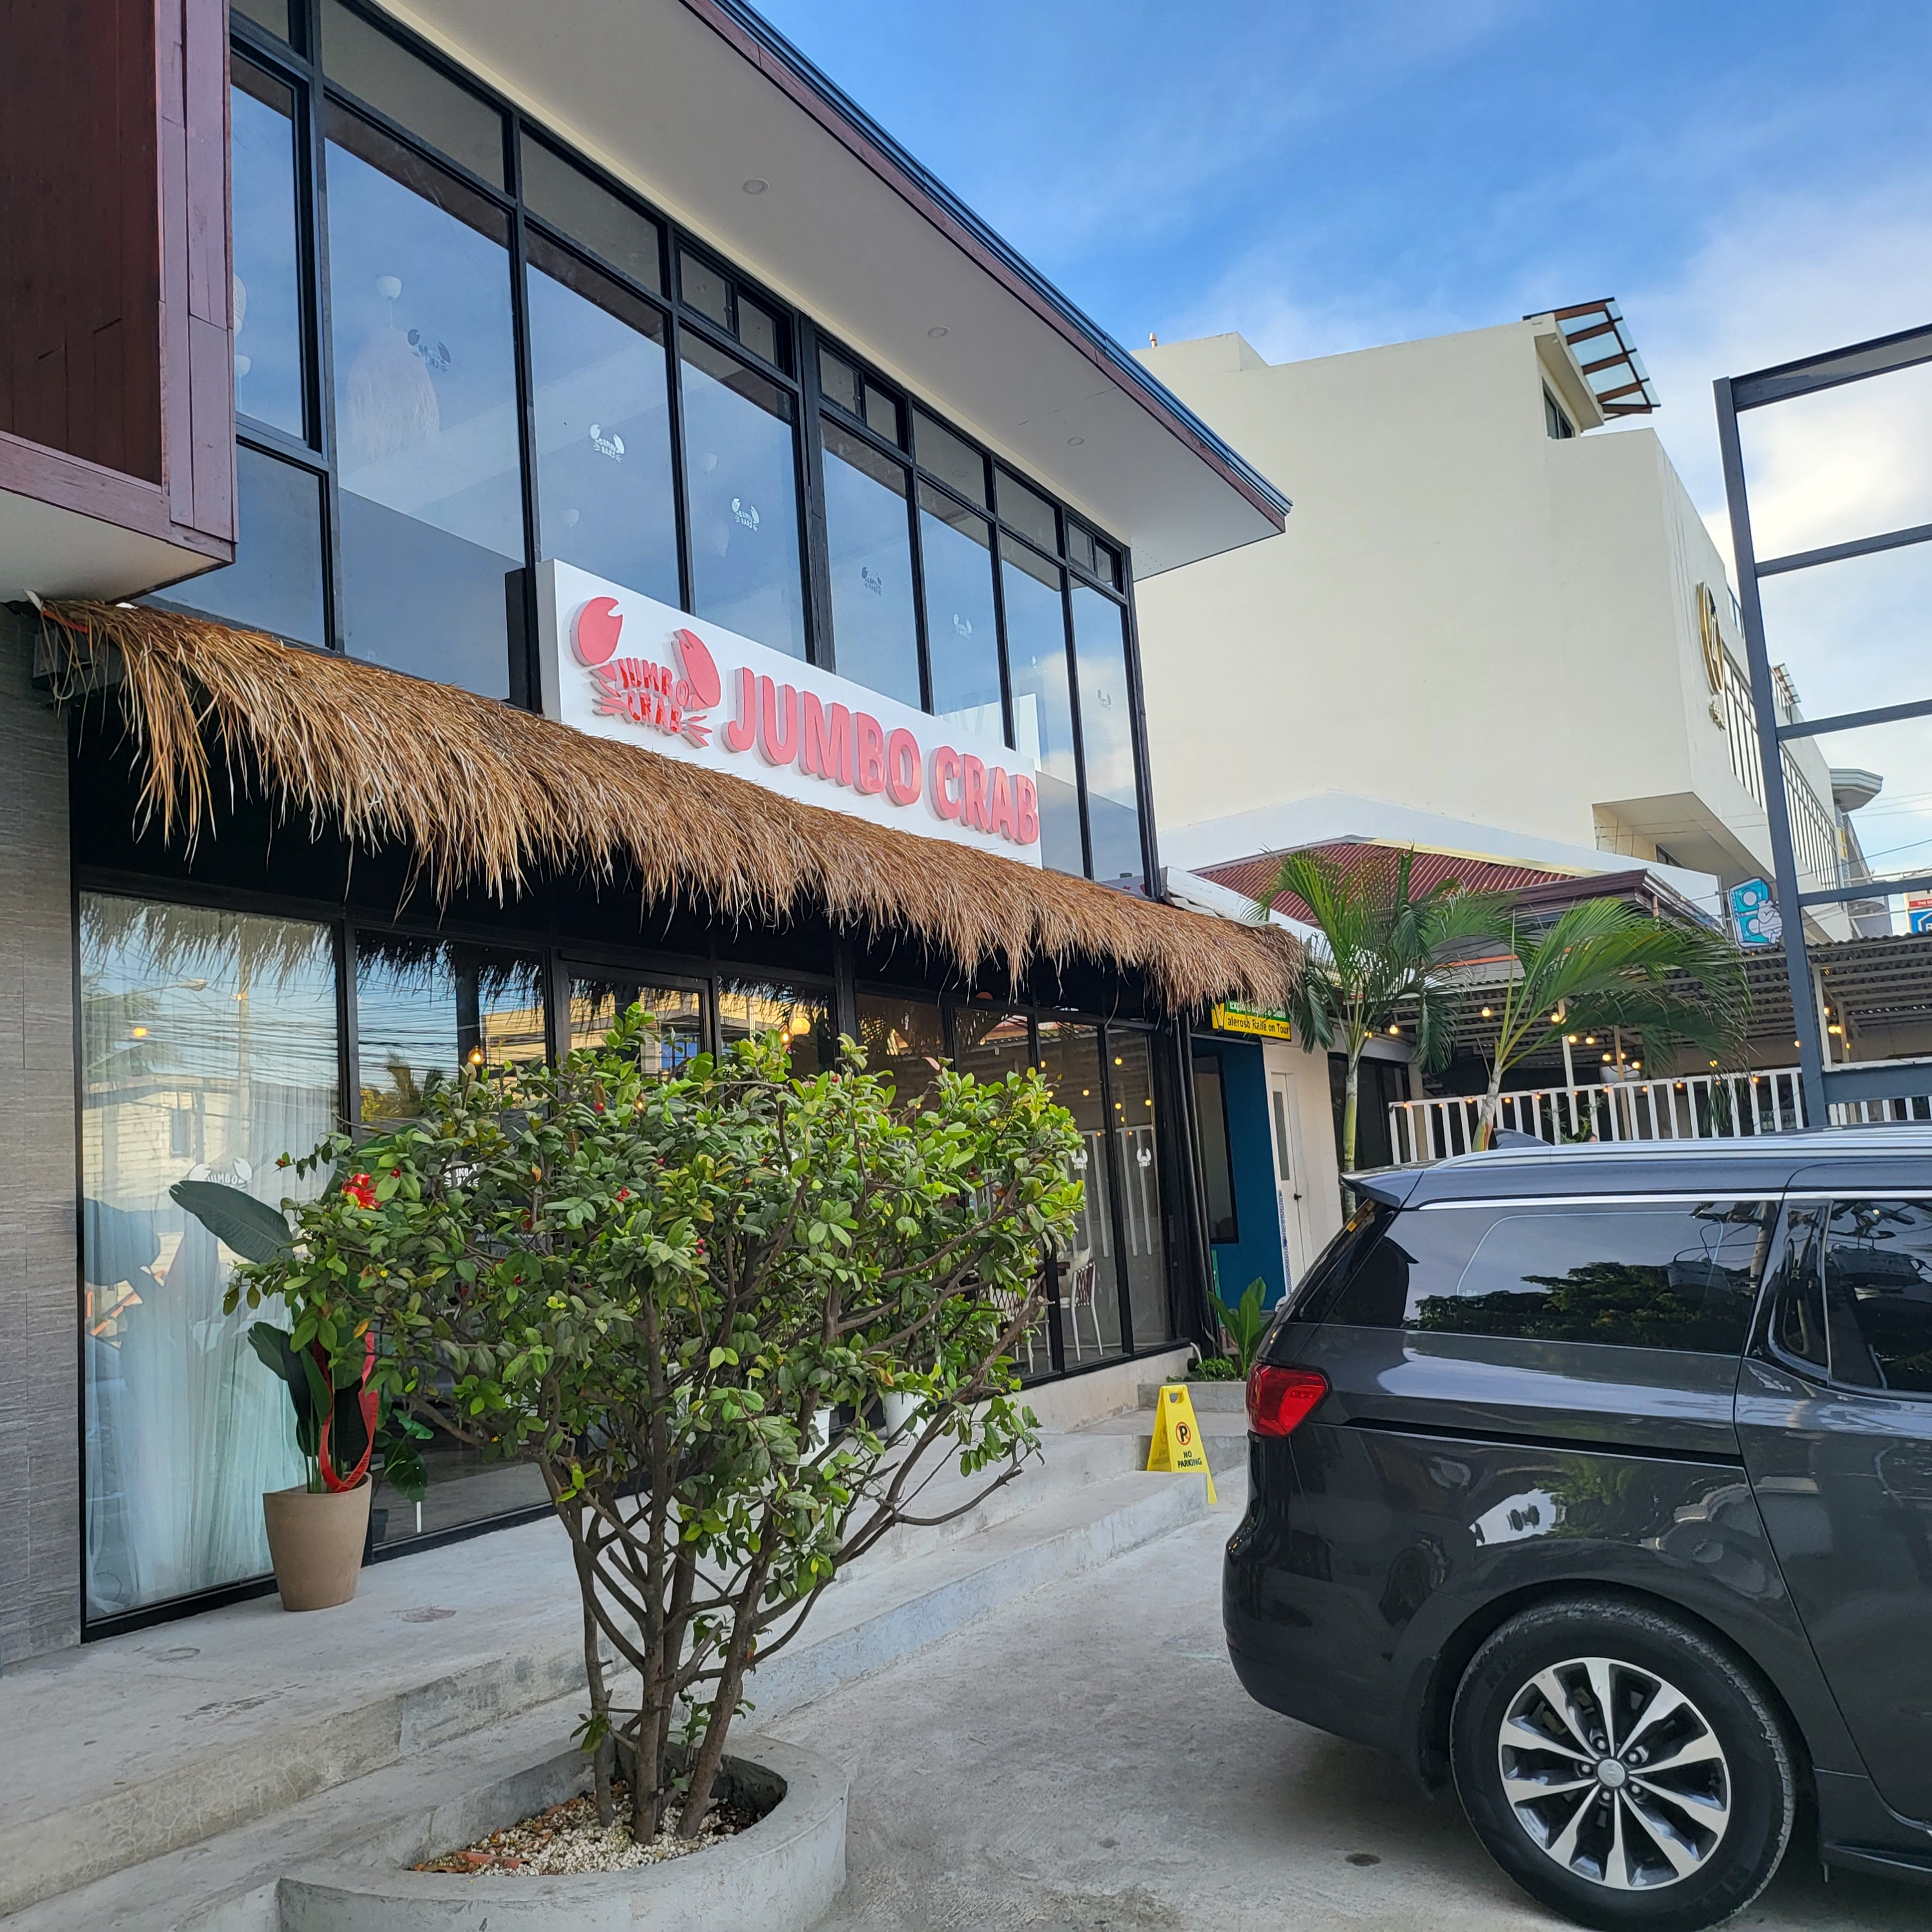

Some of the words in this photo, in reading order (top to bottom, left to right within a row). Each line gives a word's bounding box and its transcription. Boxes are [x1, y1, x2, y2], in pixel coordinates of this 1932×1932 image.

[618, 657, 690, 707] JUMBO
[628, 690, 683, 735] CRAB
[723, 666, 922, 807] JUMBO
[930, 745, 1039, 845] CRAB
[1277, 1023, 1289, 1034] Tour
[1177, 1457, 1202, 1468] PARKING
